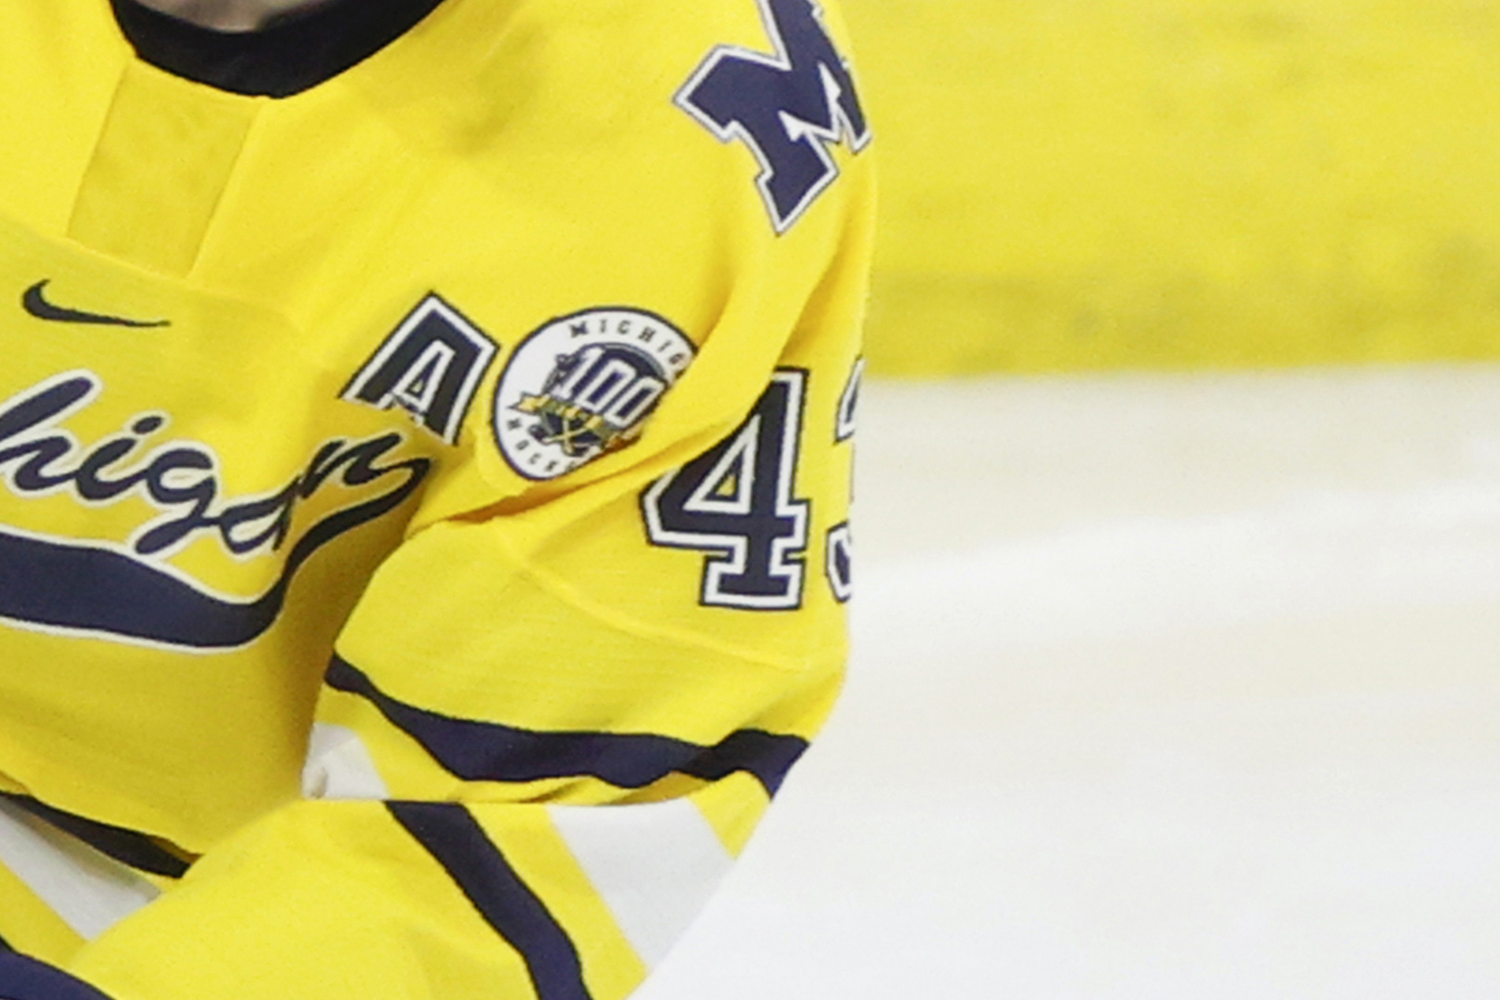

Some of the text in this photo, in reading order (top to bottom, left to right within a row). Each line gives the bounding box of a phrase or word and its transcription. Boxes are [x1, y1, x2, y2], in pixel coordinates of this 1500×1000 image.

[338, 290, 501, 446] A
[569, 319, 686, 365] MICHIG
[639, 366, 866, 611] 4
